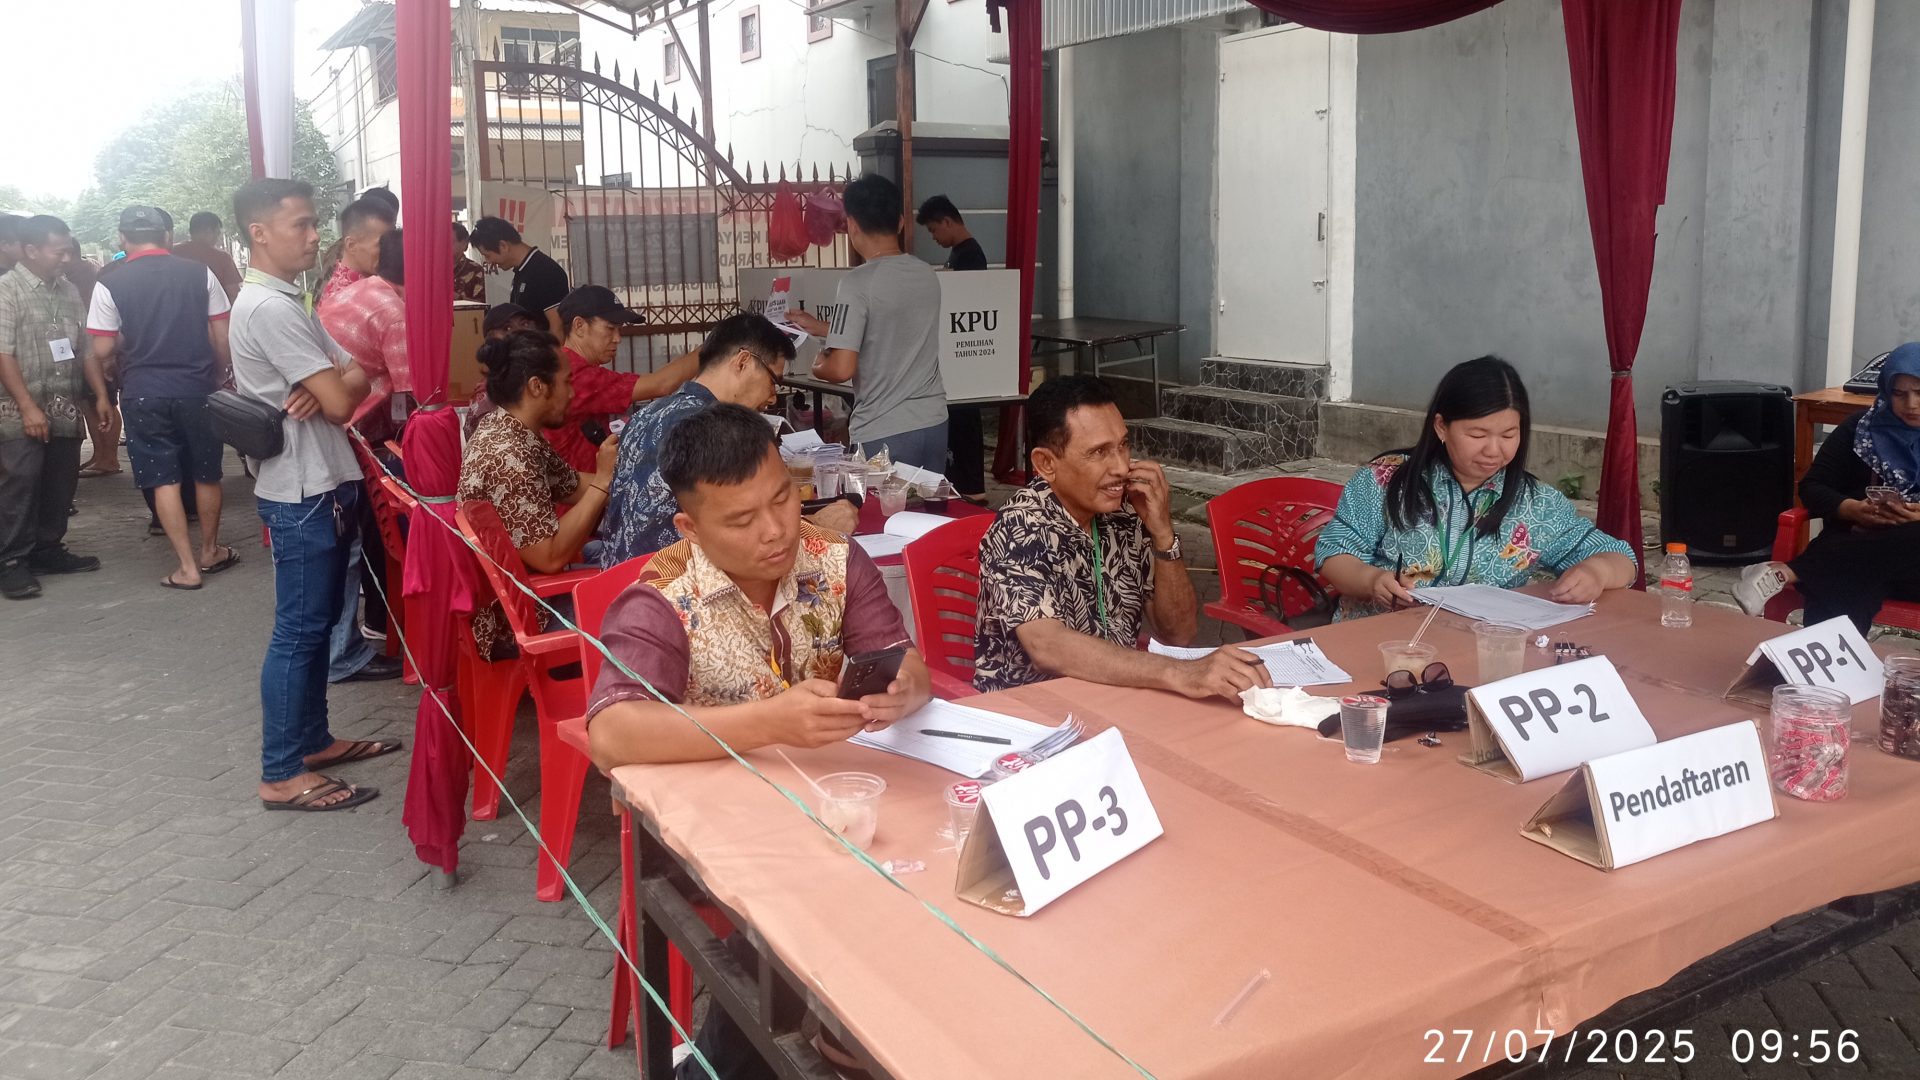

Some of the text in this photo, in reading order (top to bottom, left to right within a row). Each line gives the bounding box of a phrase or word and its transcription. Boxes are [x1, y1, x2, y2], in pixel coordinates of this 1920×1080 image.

[949, 309, 999, 334] KPU
[956, 339, 994, 348] PEMILIHAN
[954, 348, 995, 358] TAHUN 2024
[1787, 633, 1867, 686] PP-1
[1498, 682, 1611, 742] PP-2
[1608, 758, 1751, 822] Pendaftaran
[1023, 785, 1129, 881] PP-3
